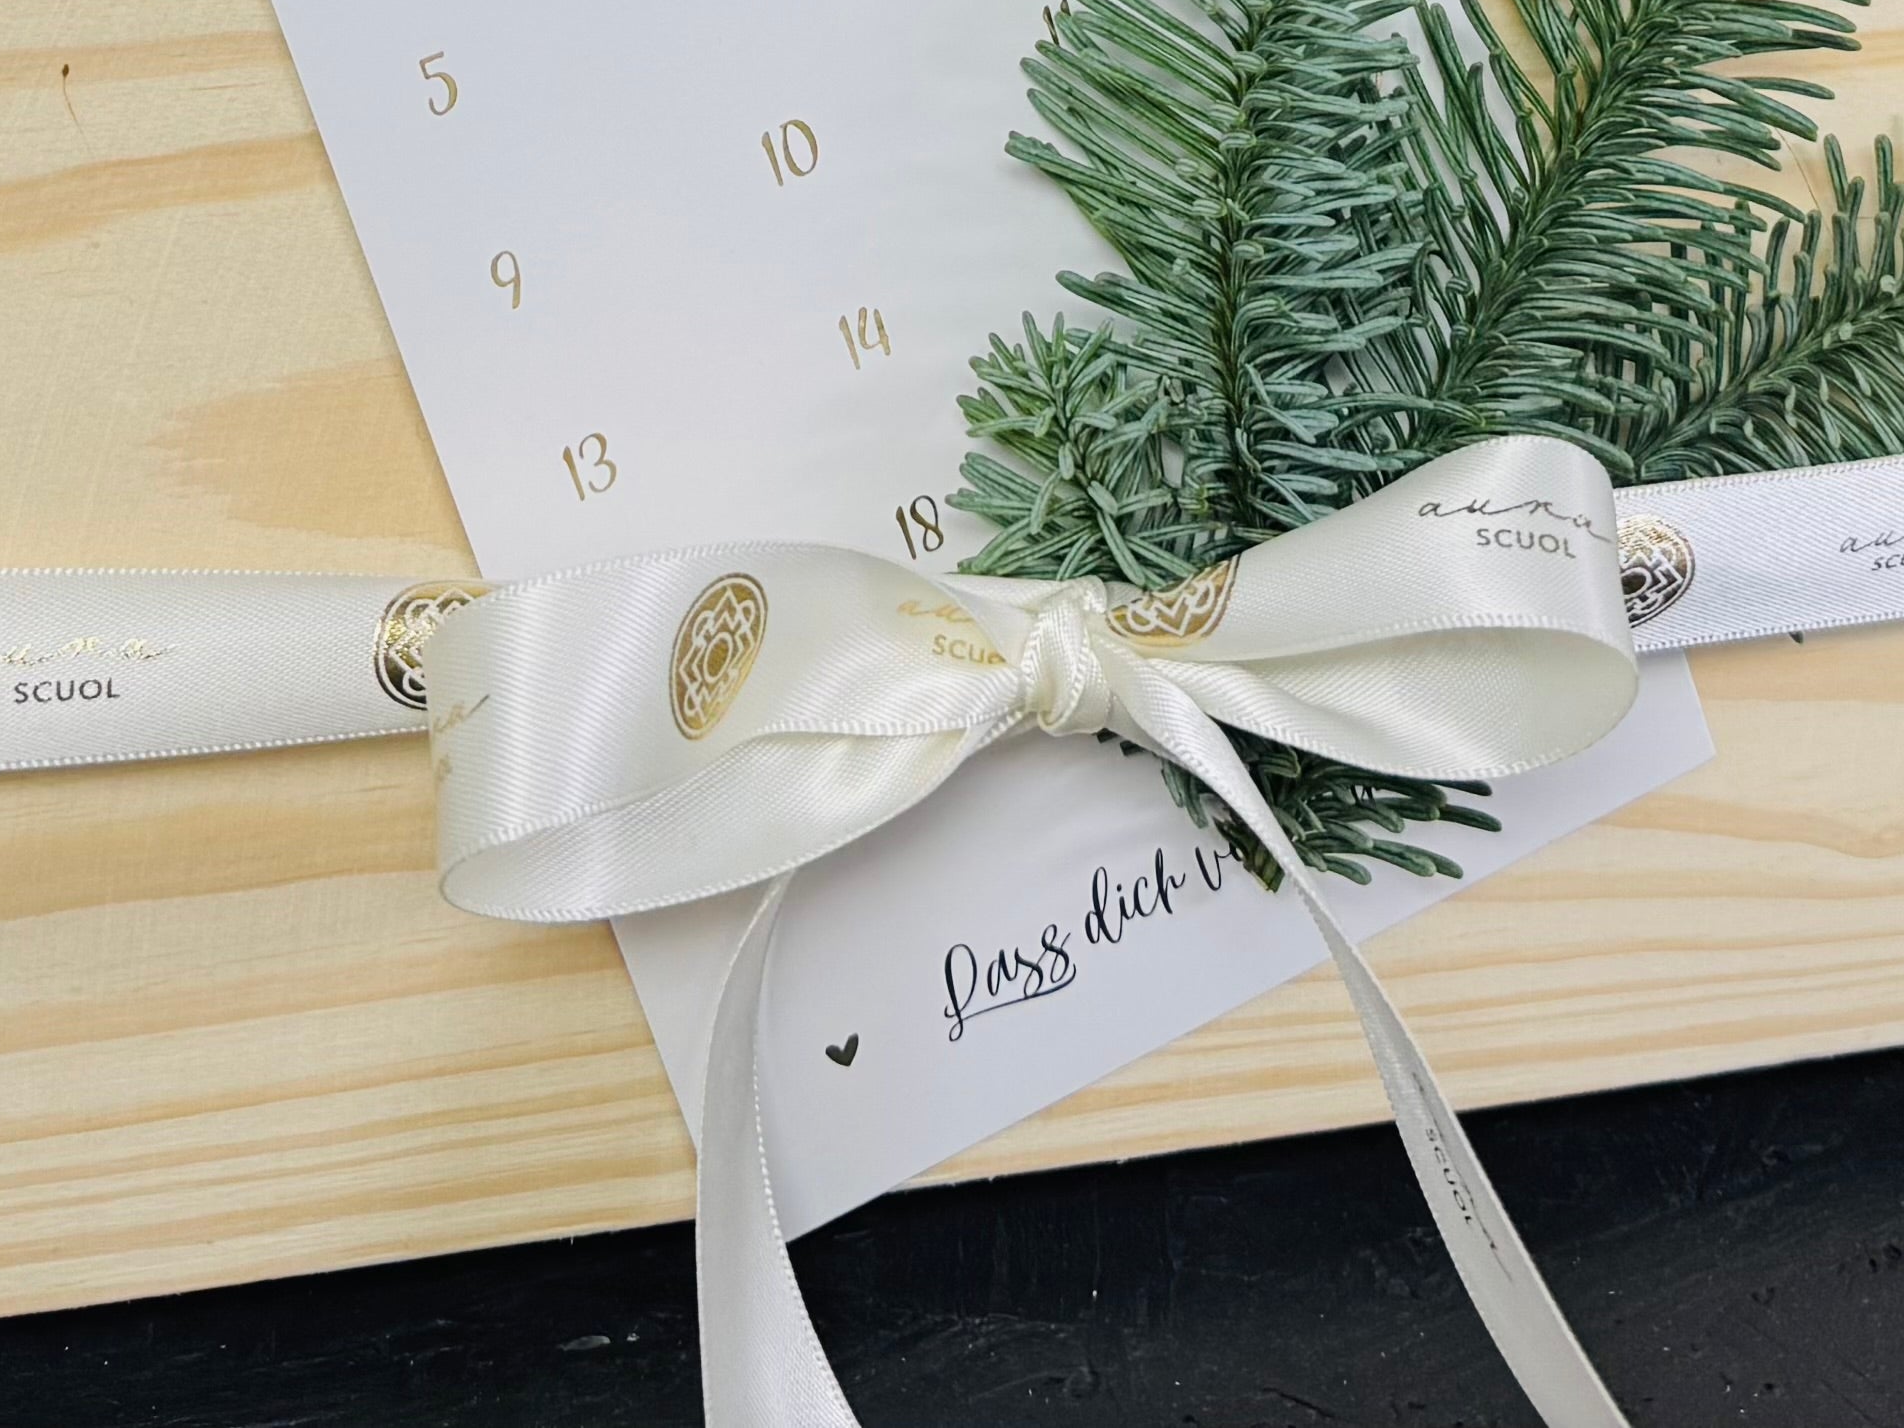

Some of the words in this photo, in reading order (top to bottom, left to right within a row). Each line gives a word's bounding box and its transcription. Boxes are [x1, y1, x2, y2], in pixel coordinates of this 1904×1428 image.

[418, 50, 458, 116] 5
[760, 118, 819, 187] 10
[489, 250, 522, 310] 9
[838, 306, 892, 370] 14
[561, 432, 617, 501] 13
[895, 495, 945, 560] 18
[1475, 528, 1577, 559] SCUOL
[13, 677, 121, 705] SCUOL
[1084, 847, 1187, 945] dich
